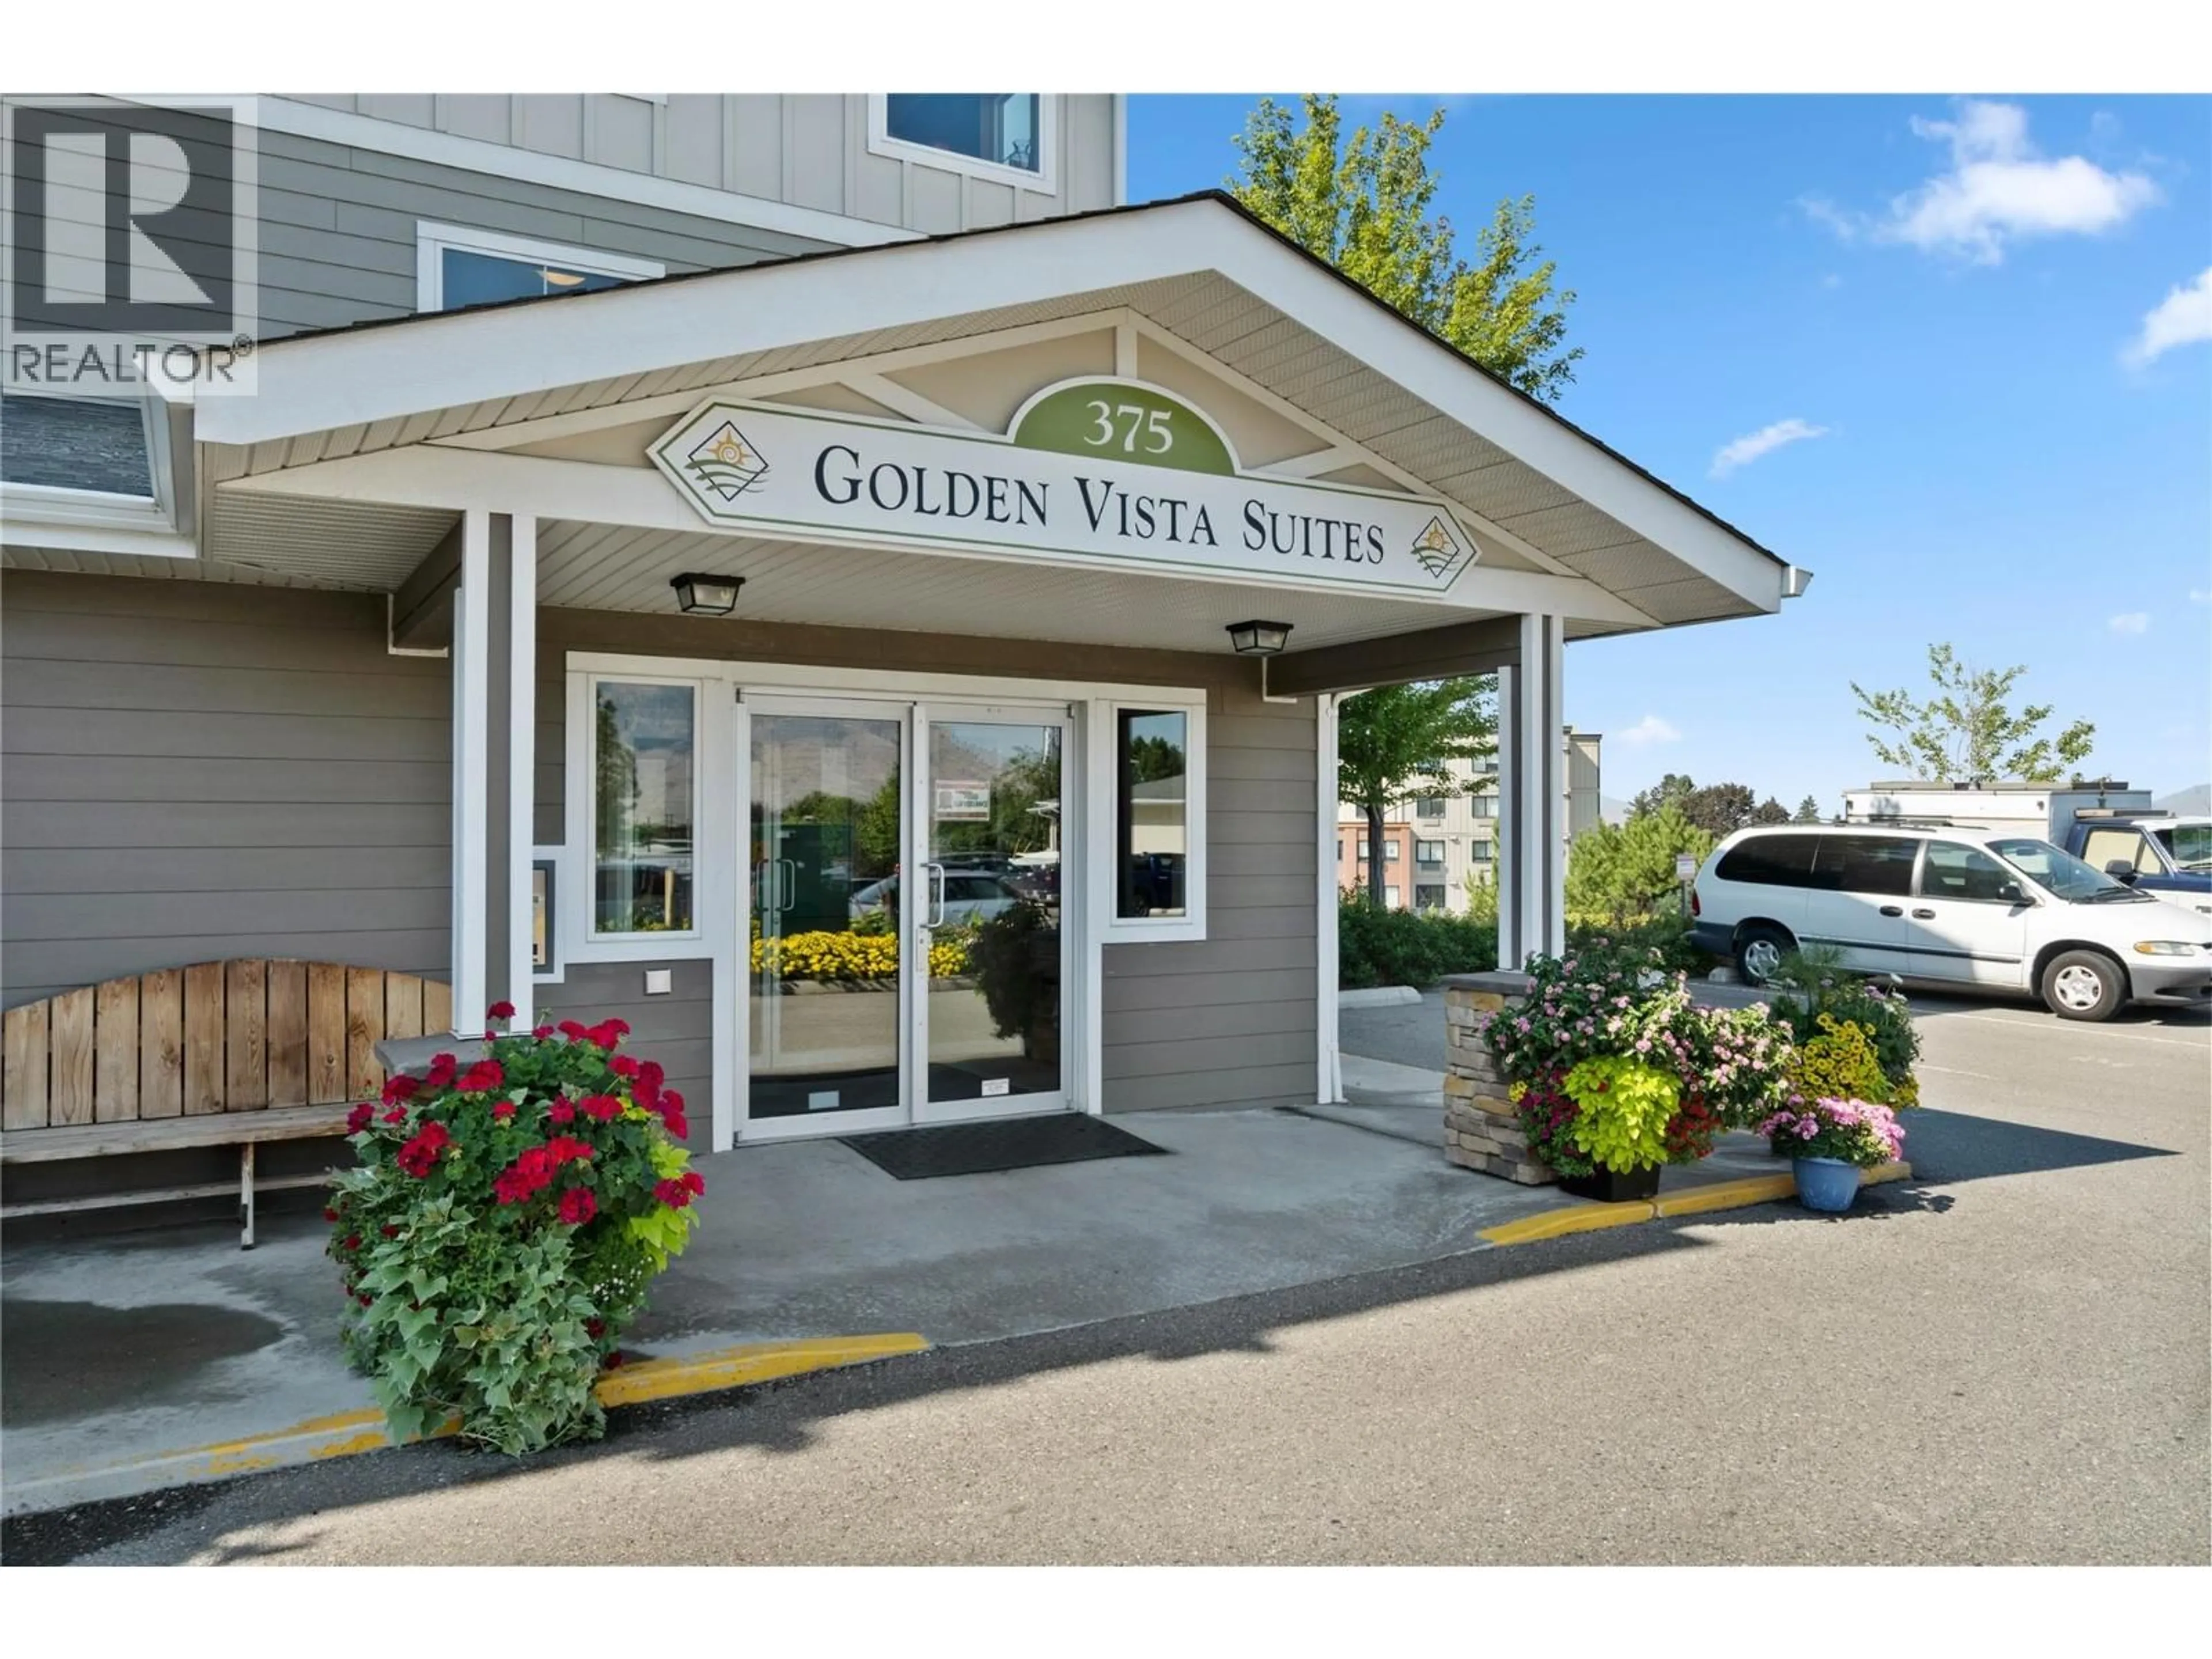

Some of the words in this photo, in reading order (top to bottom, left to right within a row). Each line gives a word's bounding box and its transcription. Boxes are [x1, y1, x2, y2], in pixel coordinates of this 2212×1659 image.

[1084, 400, 1173, 453] 375
[815, 445, 1050, 527] GOLDEN
[1074, 476, 1218, 546] VISTA
[1243, 499, 1384, 565] SUITES
